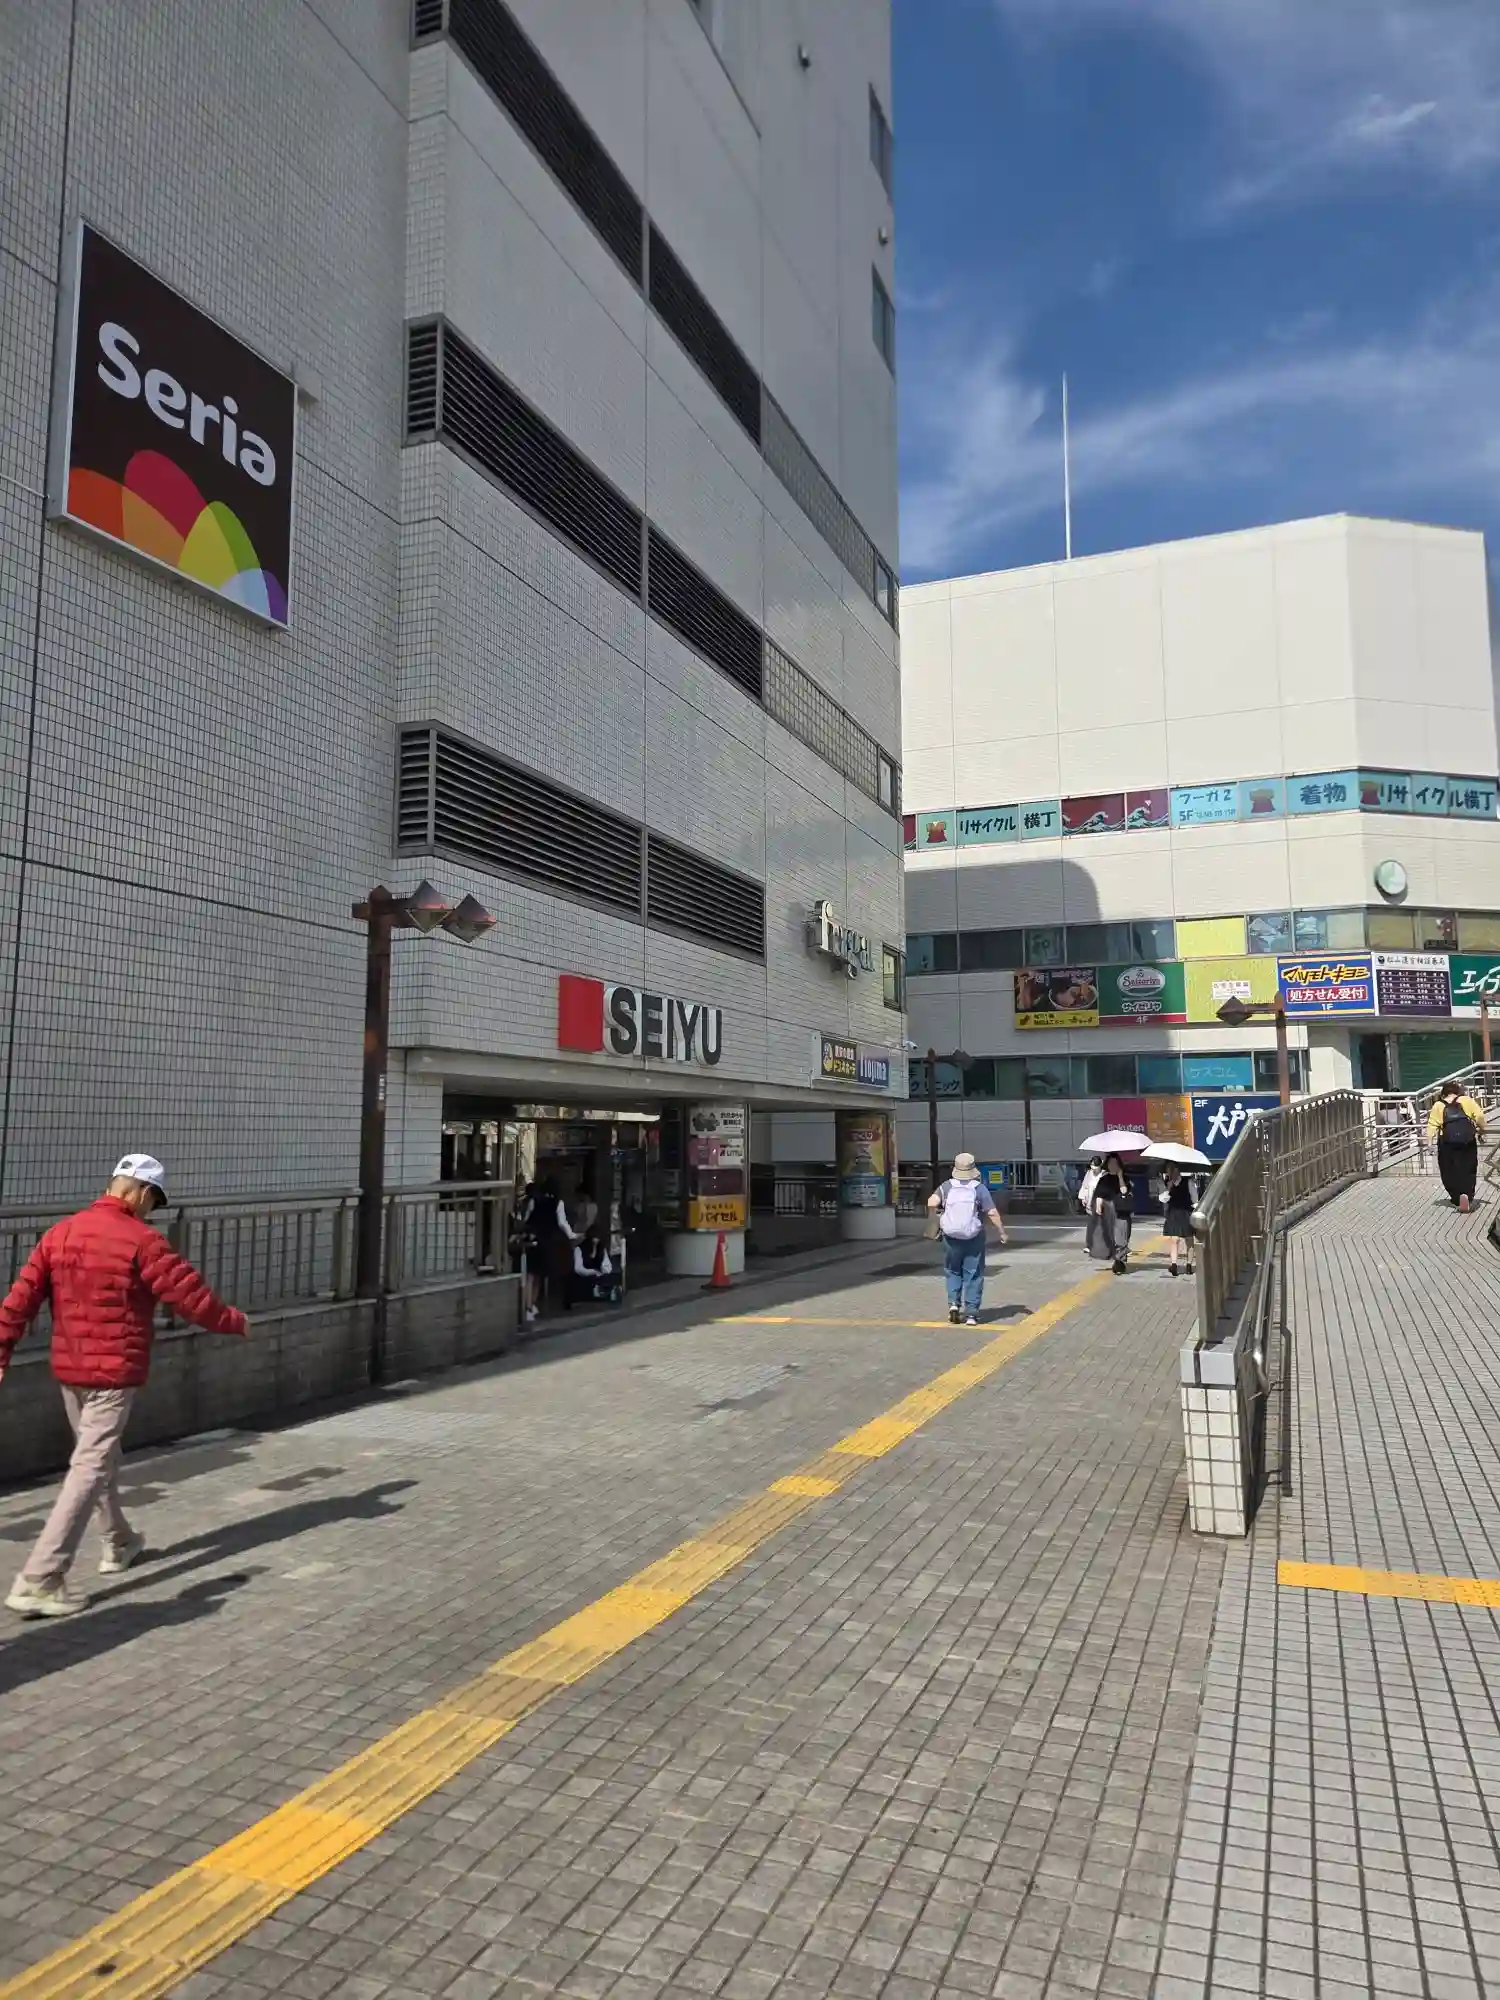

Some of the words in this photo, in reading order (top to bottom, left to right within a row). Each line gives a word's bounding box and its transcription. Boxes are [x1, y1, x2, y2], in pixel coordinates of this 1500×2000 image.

[96, 321, 276, 488] Seria
[1300, 784, 1347, 806] 着物
[1281, 965, 1371, 985] マツモトキヨシ
[1289, 987, 1365, 1003] 処方せん受付
[605, 987, 723, 1065] SEIYU
[1194, 1099, 1209, 1108] 2F
